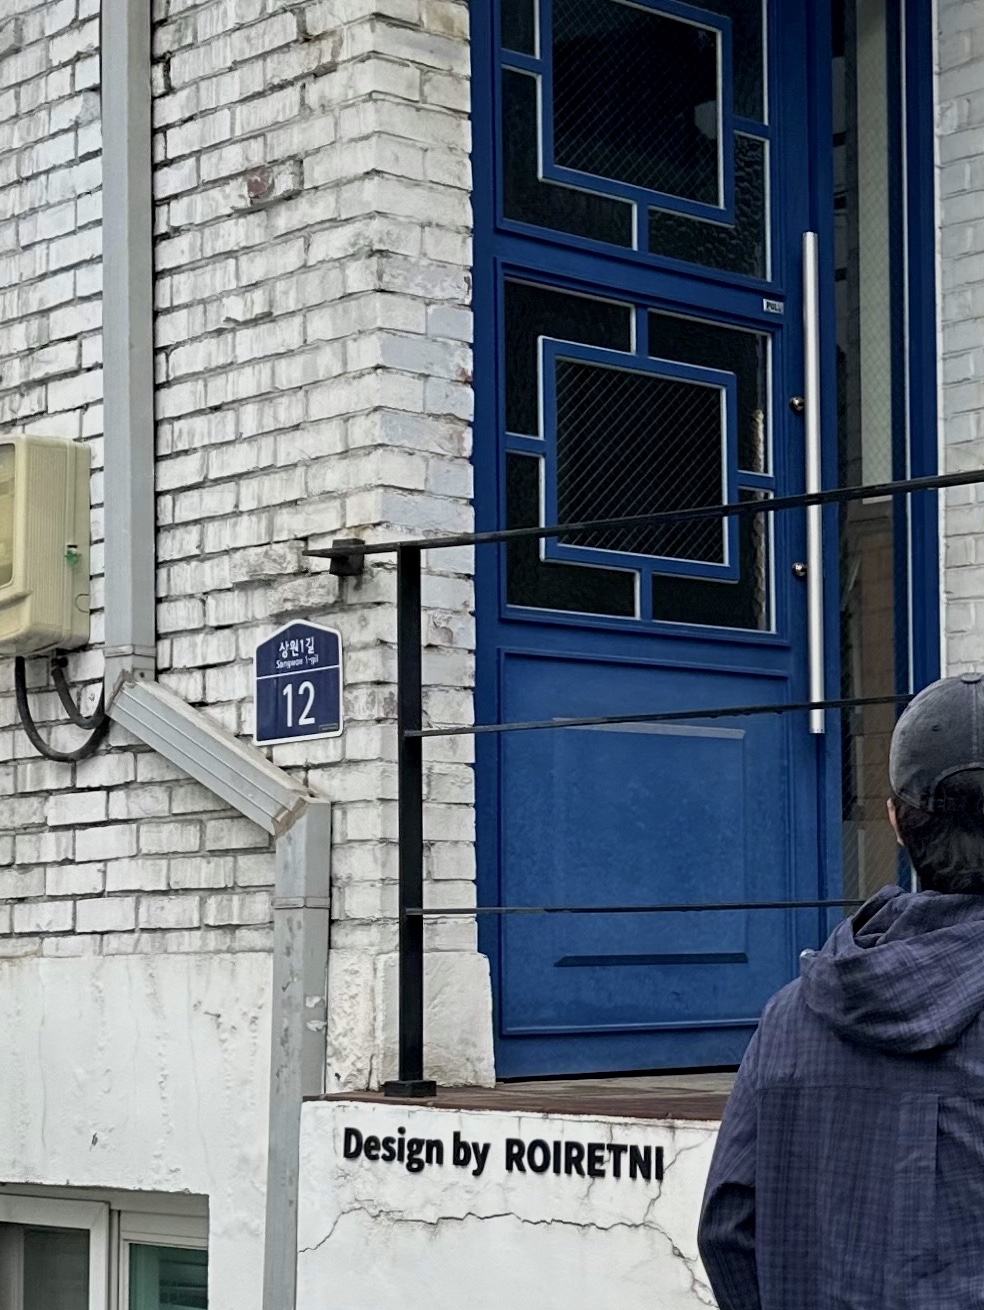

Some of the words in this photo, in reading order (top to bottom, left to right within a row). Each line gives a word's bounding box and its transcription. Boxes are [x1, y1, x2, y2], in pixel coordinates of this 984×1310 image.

[279, 636, 315, 658] 상원1길
[282, 680, 316, 728] 12
[343, 1126, 444, 1173] Design
[452, 1131, 491, 1176] by
[505, 1138, 665, 1181] ROIRETNI
